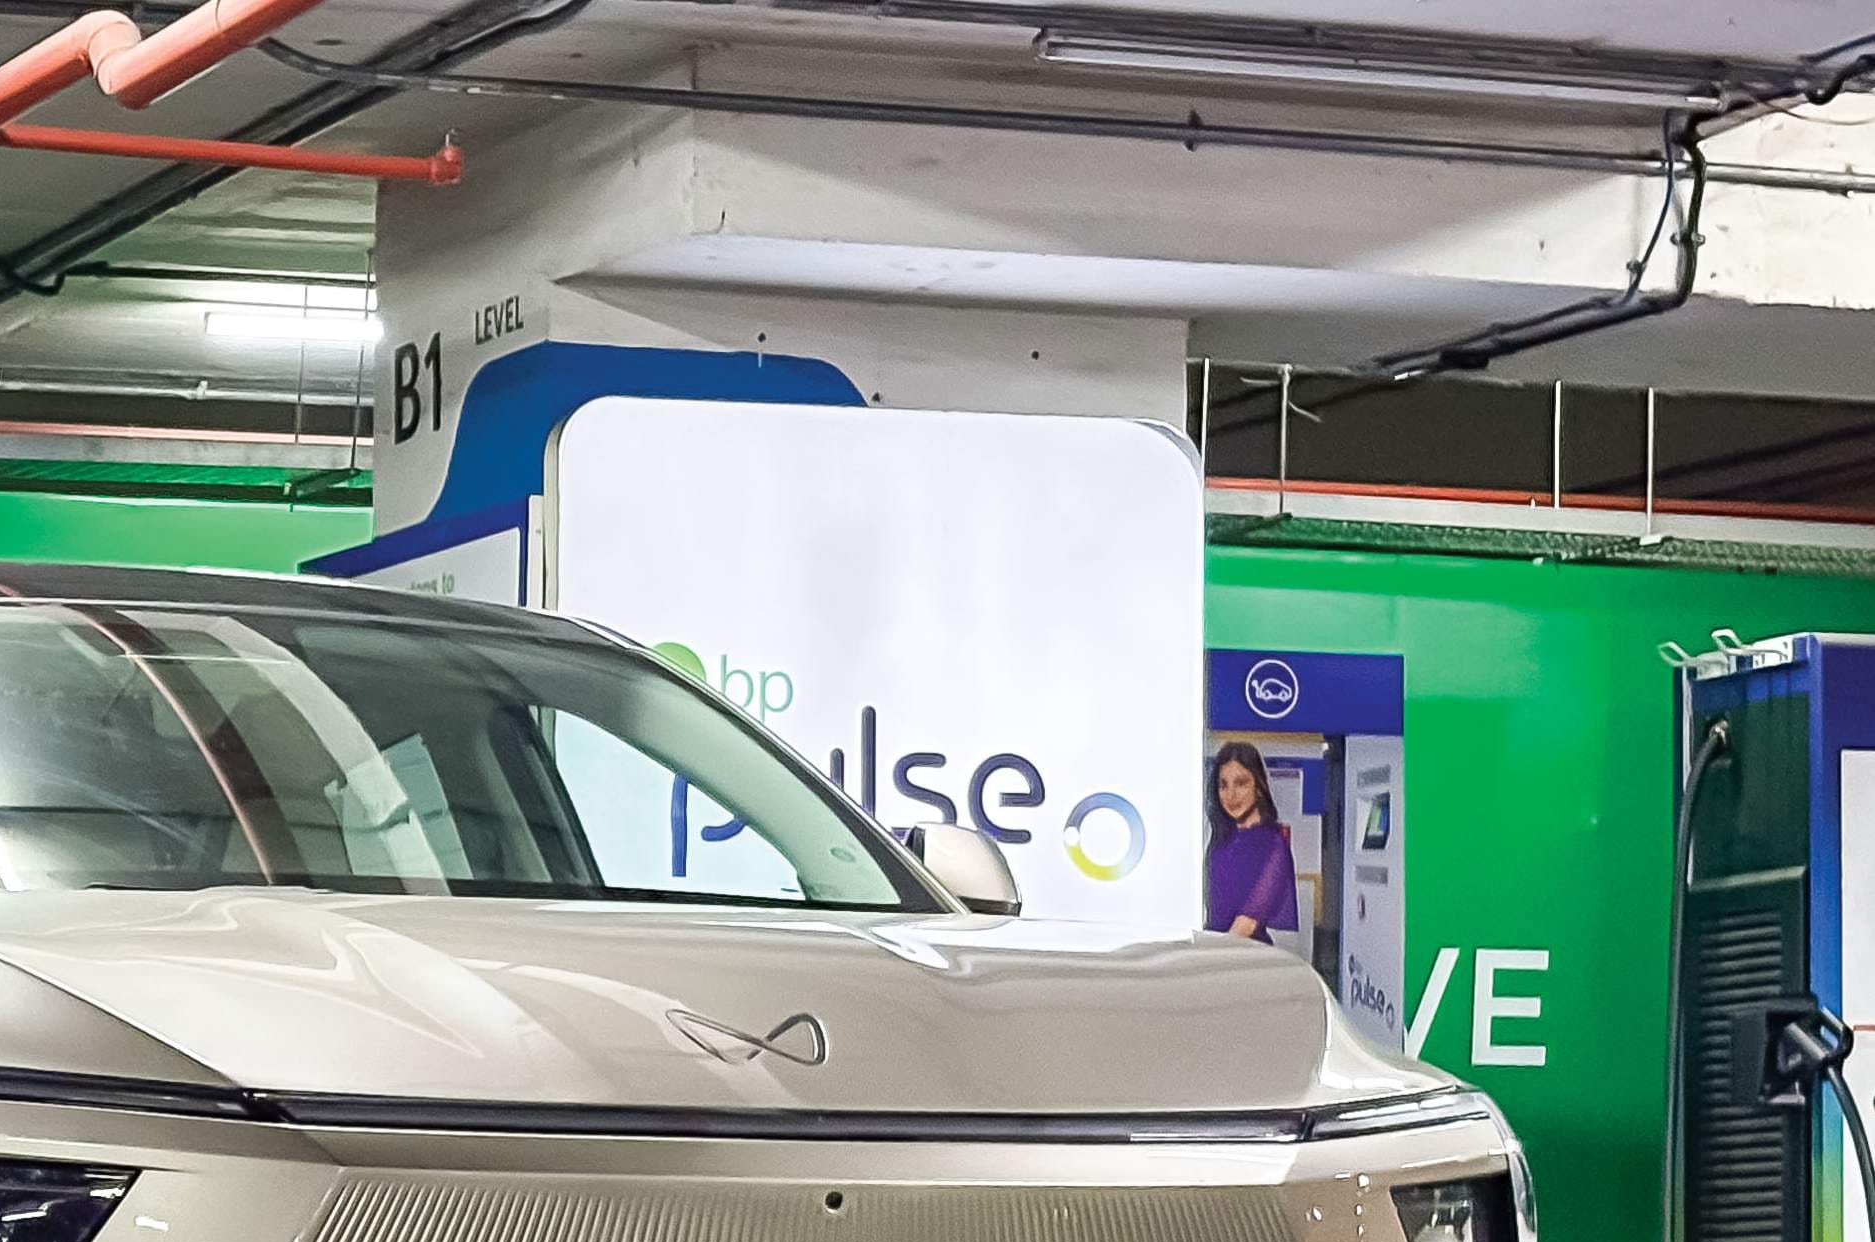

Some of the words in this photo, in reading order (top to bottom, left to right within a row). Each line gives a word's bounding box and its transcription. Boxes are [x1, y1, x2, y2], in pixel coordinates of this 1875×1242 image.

[475, 296, 524, 345] LEVEL
[394, 331, 442, 445] B1
[720, 654, 794, 722] bp
